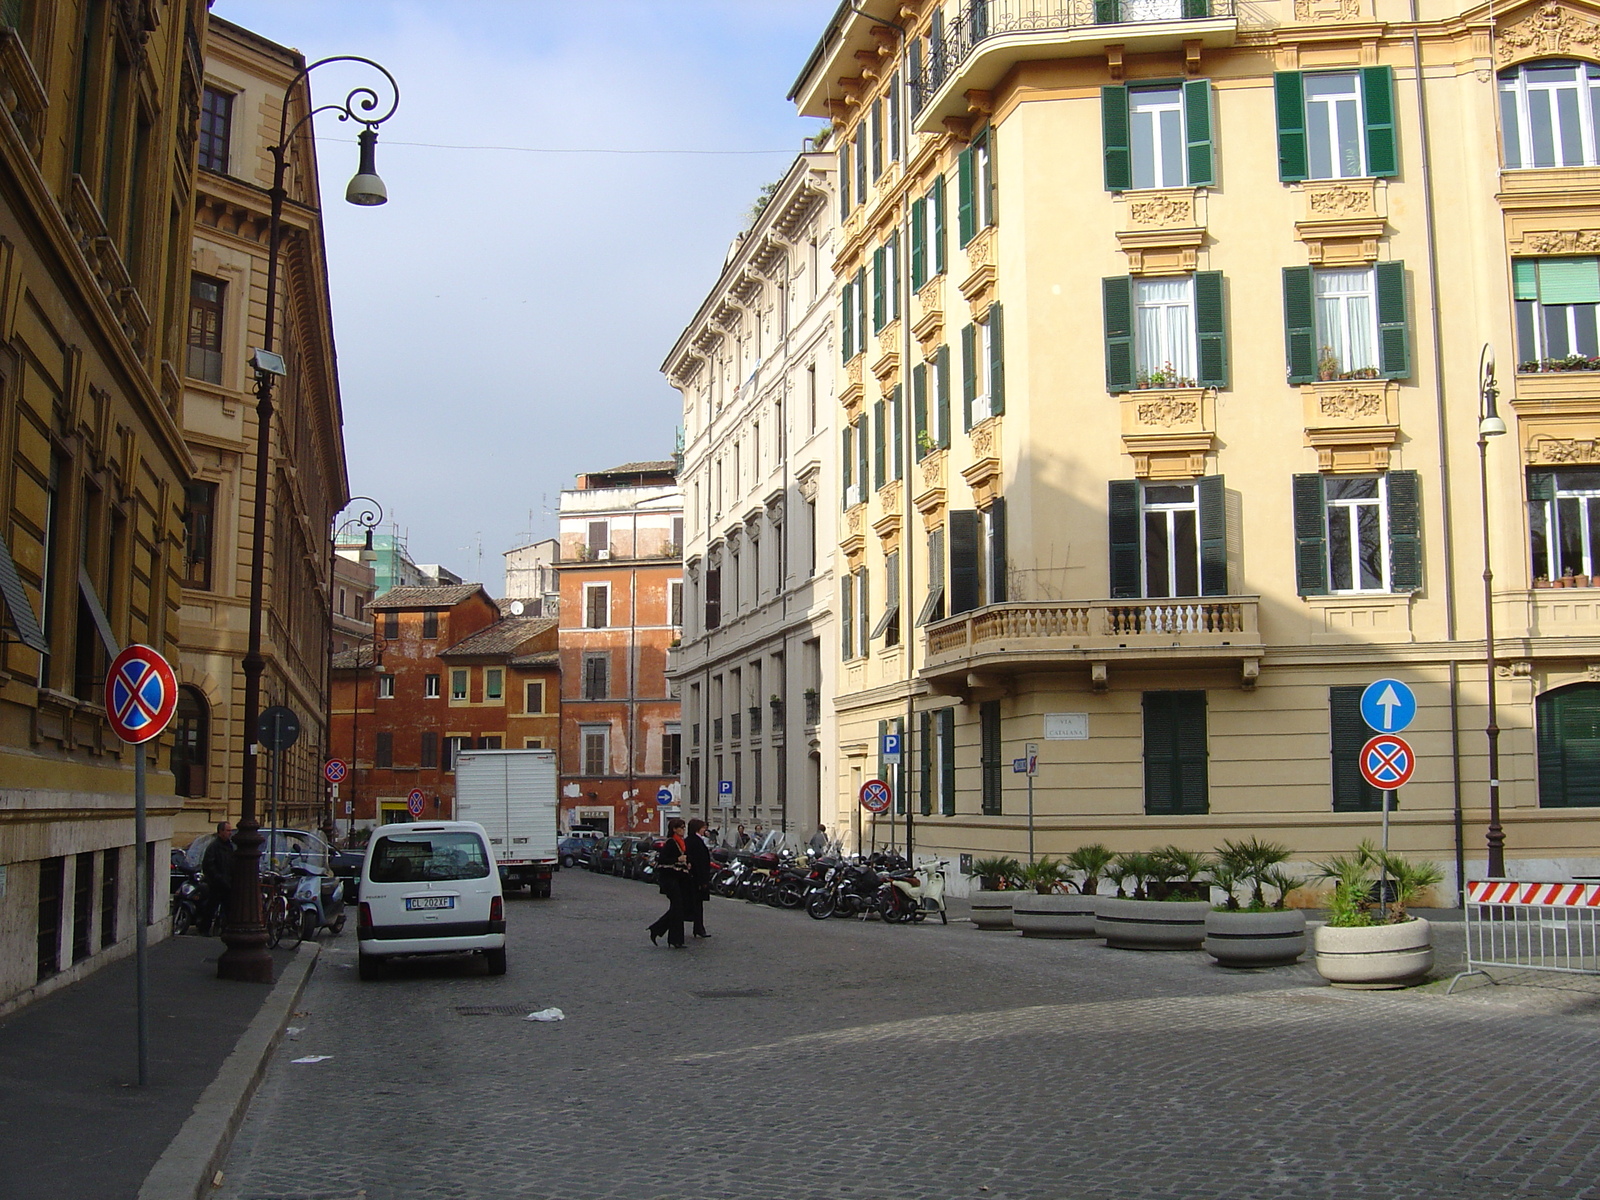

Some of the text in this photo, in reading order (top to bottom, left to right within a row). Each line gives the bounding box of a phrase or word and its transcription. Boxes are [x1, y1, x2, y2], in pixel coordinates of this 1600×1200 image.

[886, 736, 897, 753] P
[722, 782, 730, 793] P
[412, 899, 421, 907] CL
